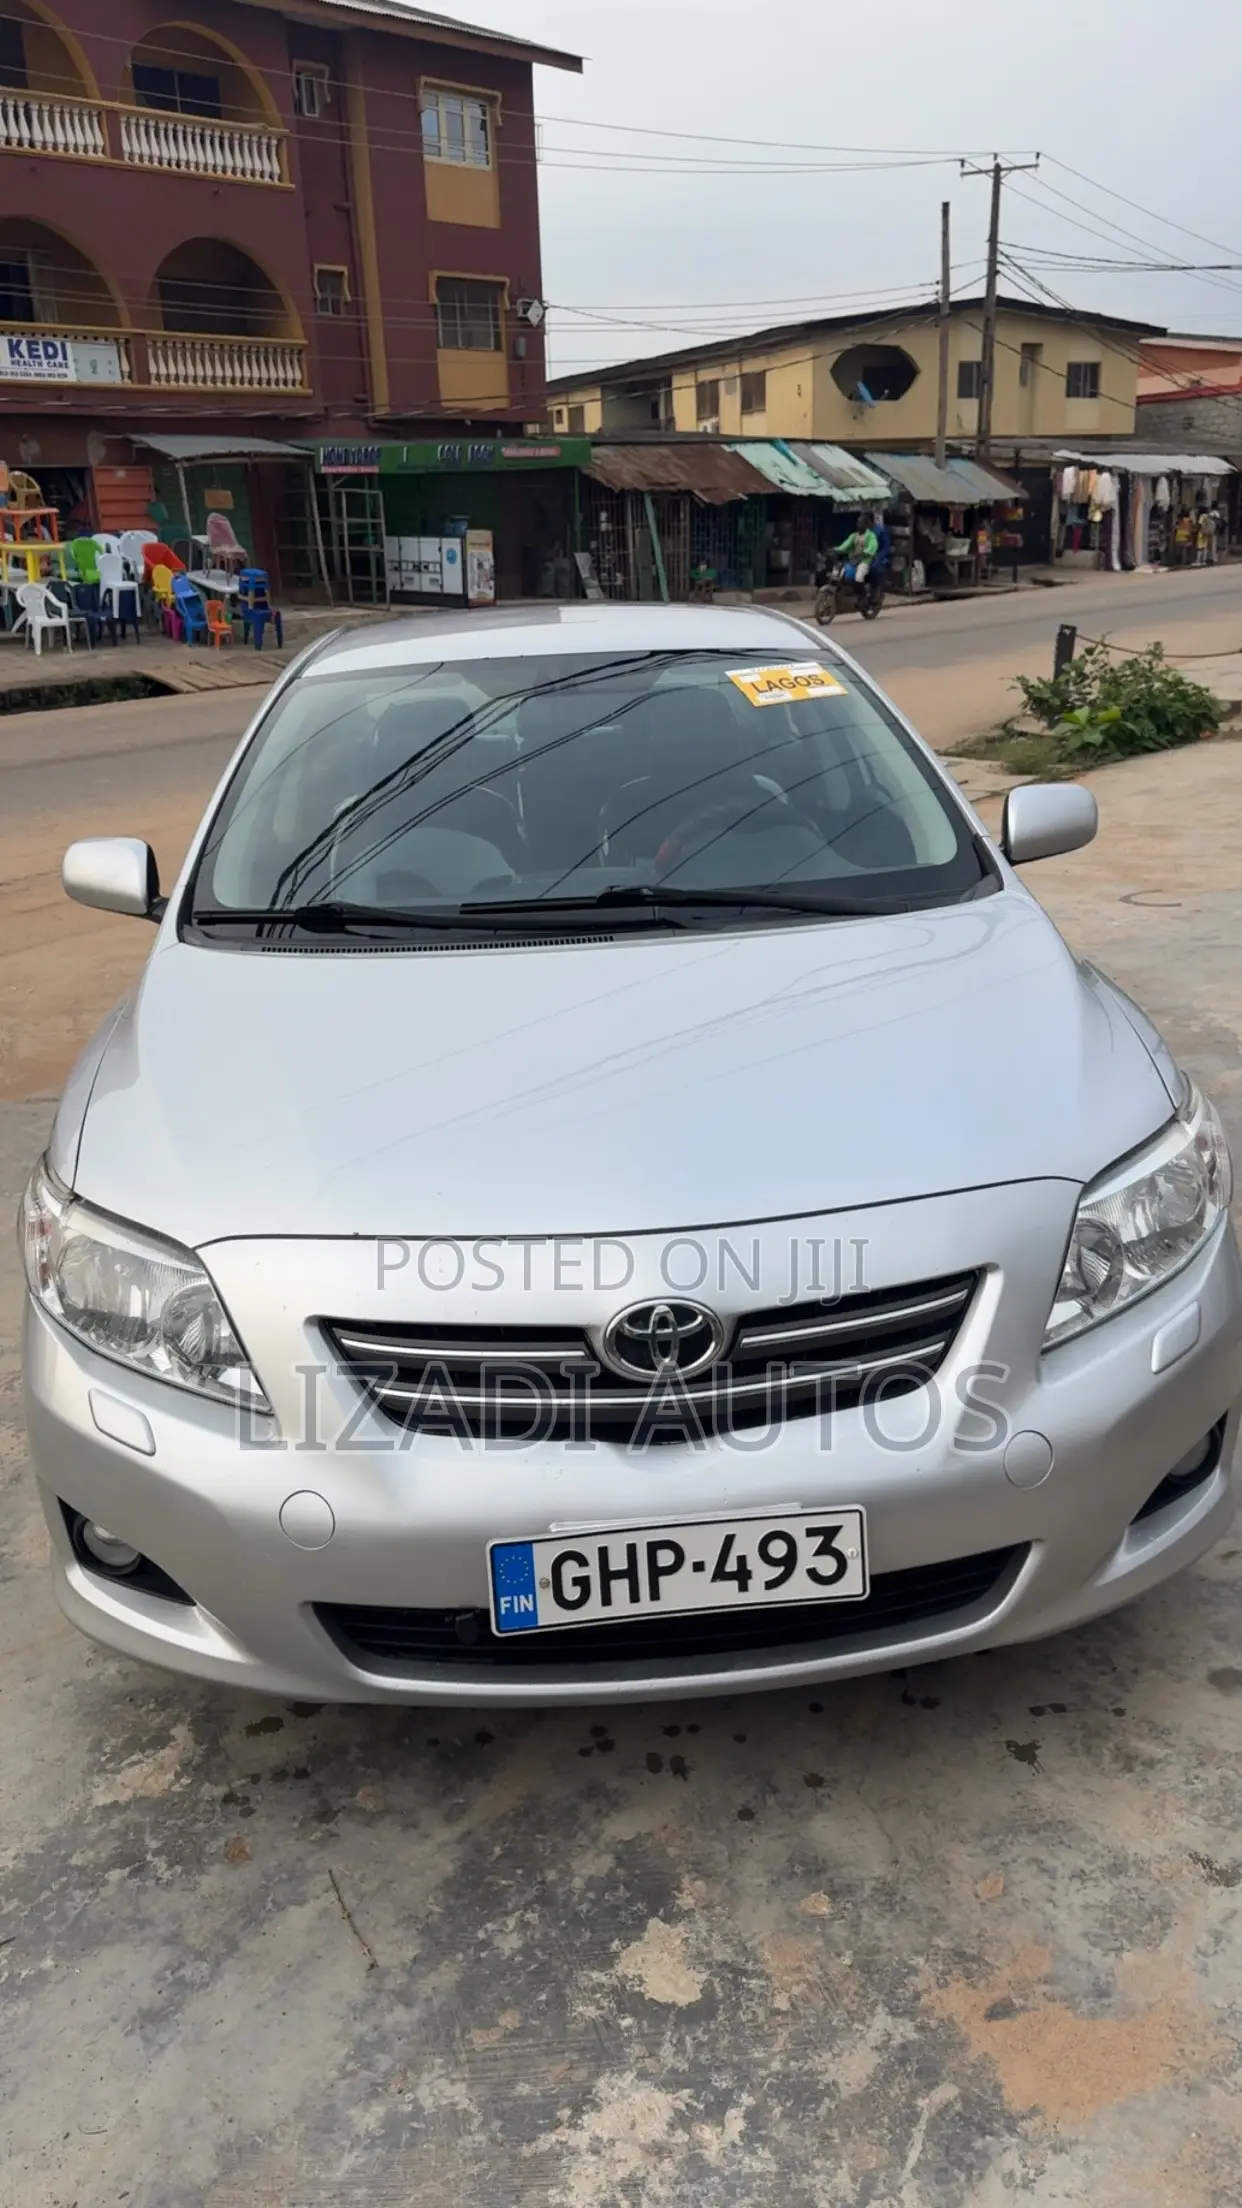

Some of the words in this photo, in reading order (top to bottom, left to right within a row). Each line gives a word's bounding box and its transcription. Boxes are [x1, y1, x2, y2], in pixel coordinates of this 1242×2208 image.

[7, 338, 68, 361] KEDI
[11, 359, 43, 368] HEALTH
[47, 360, 69, 369] CARE
[751, 674, 826, 694] LAGOS
[550, 1524, 849, 1611] GHP-493
[499, 1593, 535, 1615] FIN
